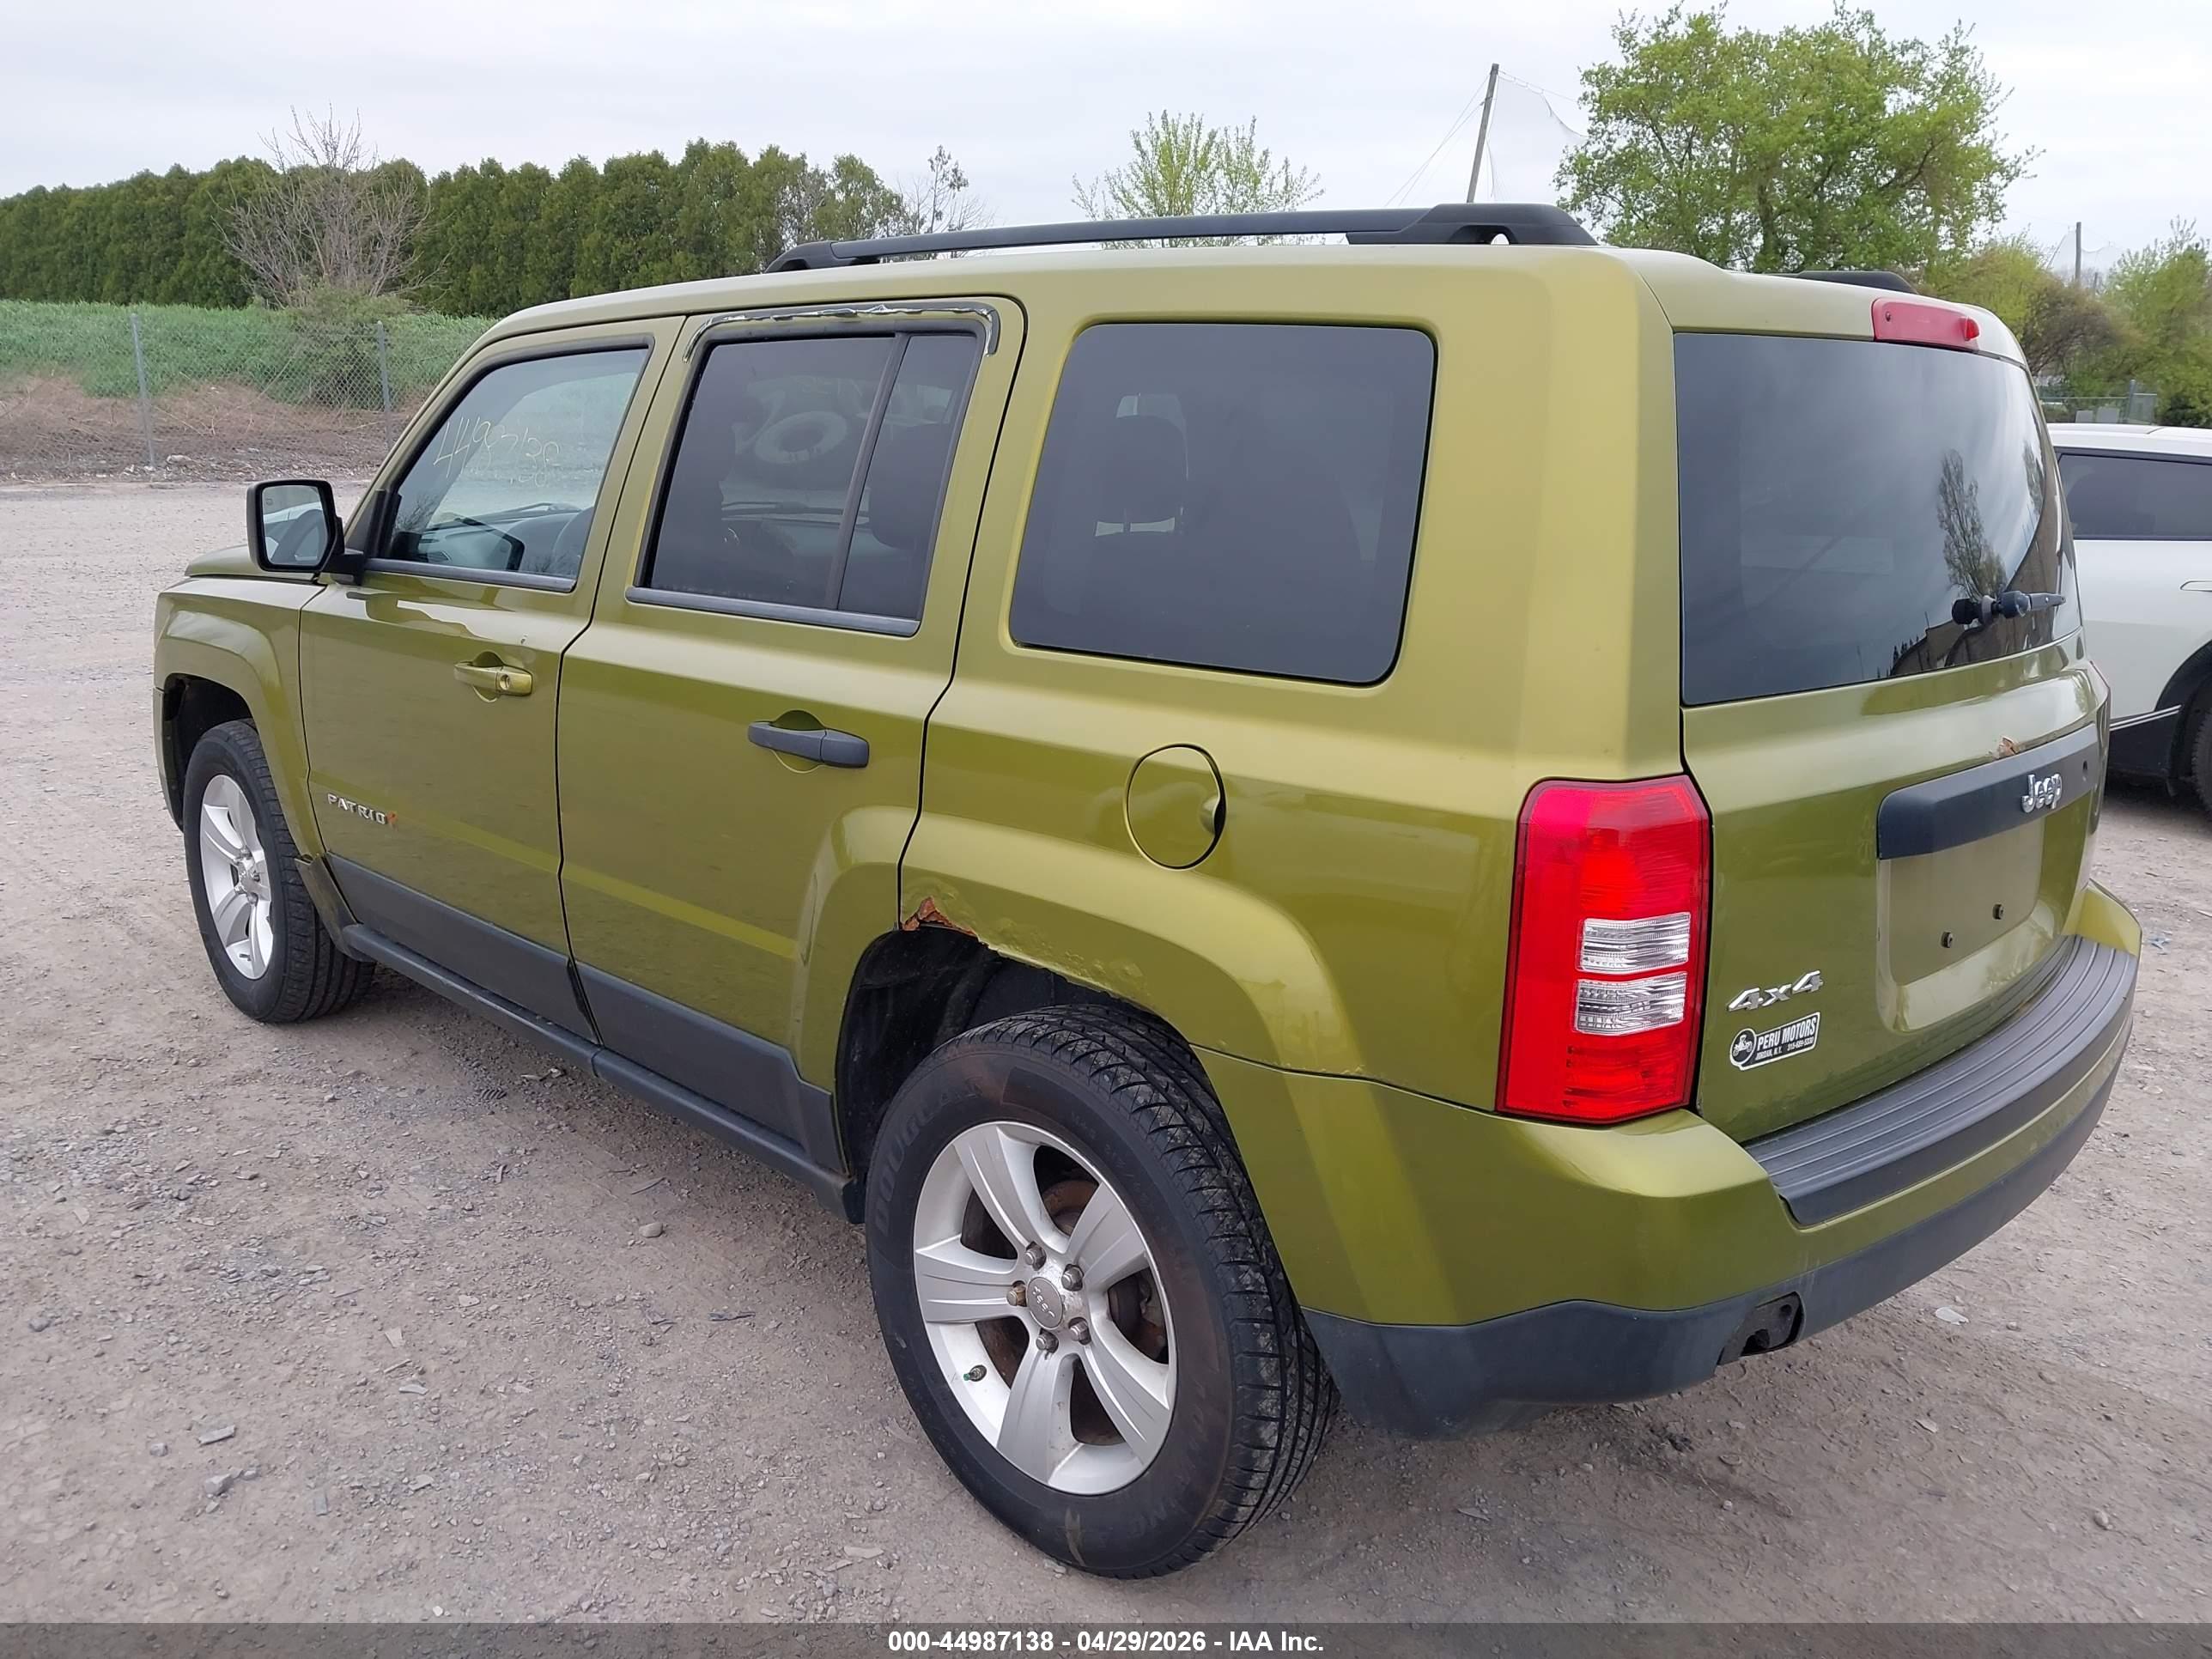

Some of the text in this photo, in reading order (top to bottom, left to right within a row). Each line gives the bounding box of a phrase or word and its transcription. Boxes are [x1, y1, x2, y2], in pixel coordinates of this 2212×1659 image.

[2022, 774, 2062, 813] Jeep
[1757, 1017, 1817, 1052] PERU MOTORS
